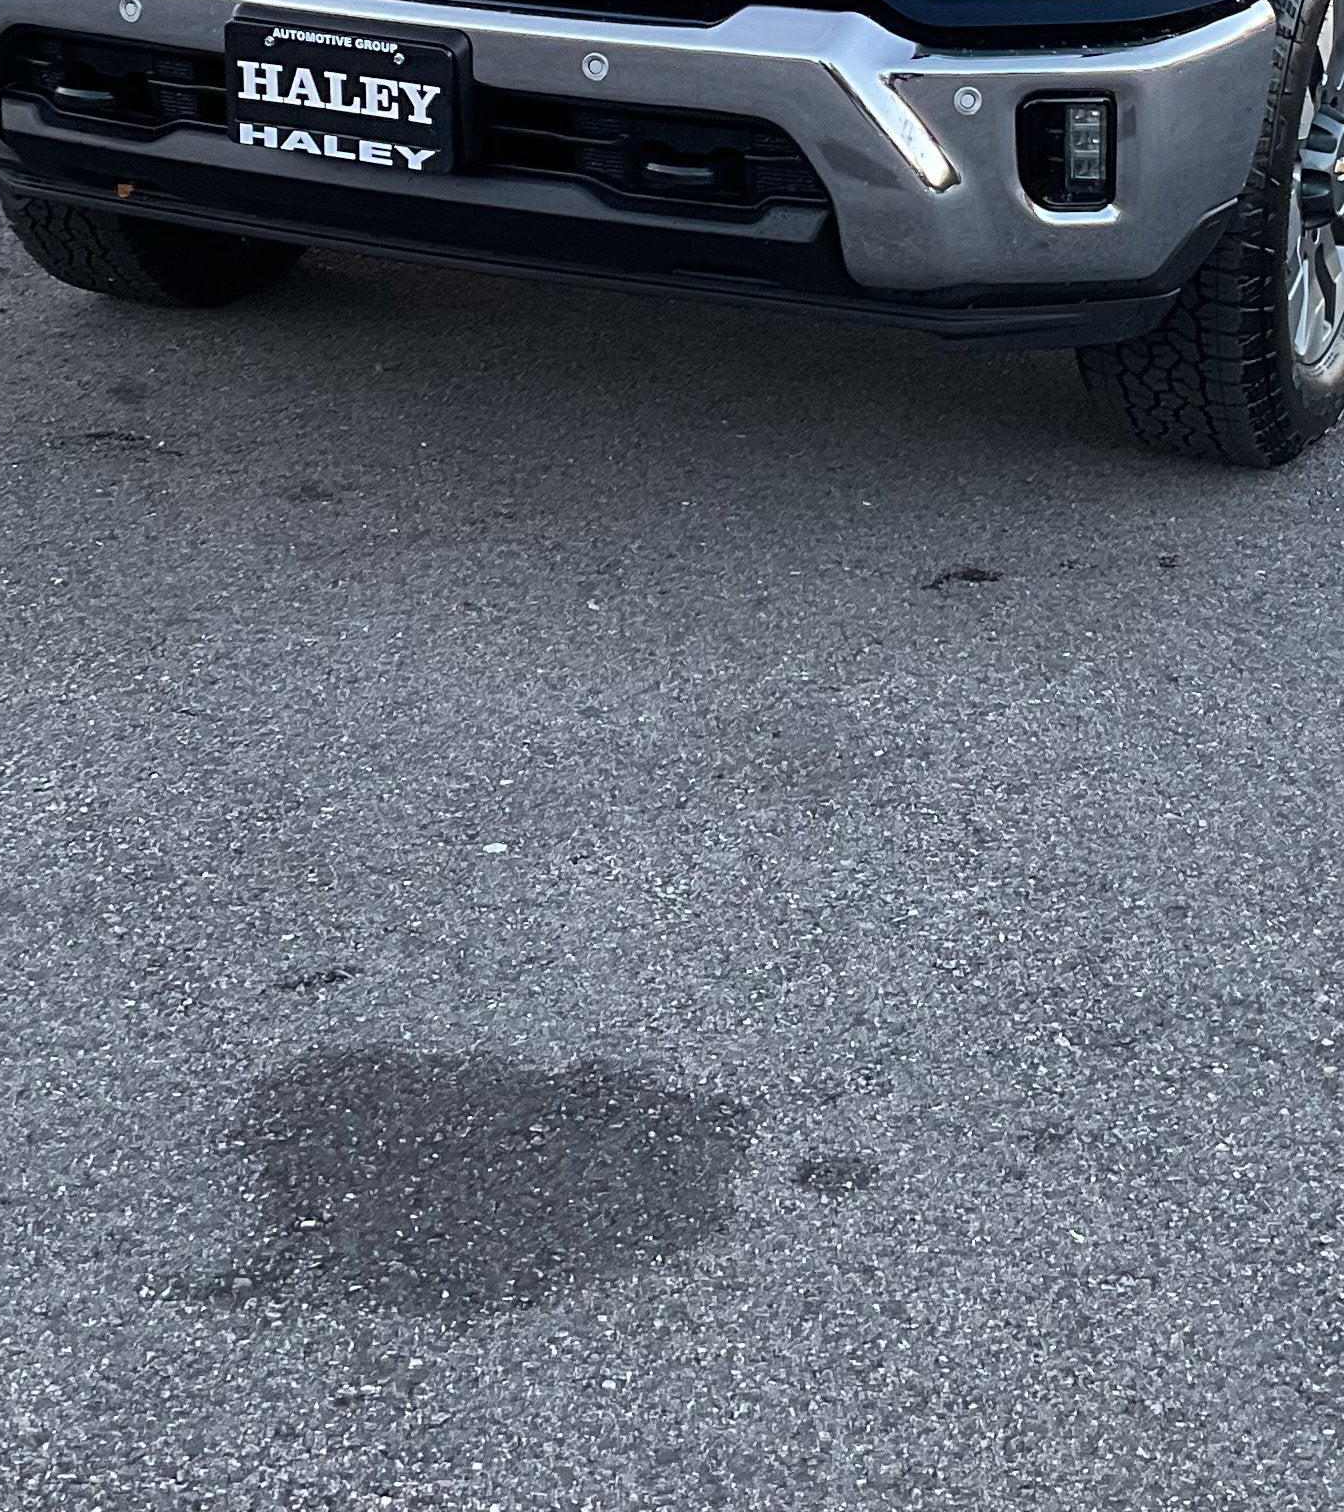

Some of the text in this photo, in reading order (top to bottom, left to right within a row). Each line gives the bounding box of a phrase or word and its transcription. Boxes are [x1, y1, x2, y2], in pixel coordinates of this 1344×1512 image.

[272, 27, 399, 54] AUTOMOTIVE GROUP
[236, 59, 441, 125] HALEY
[238, 122, 437, 171] HALEY
